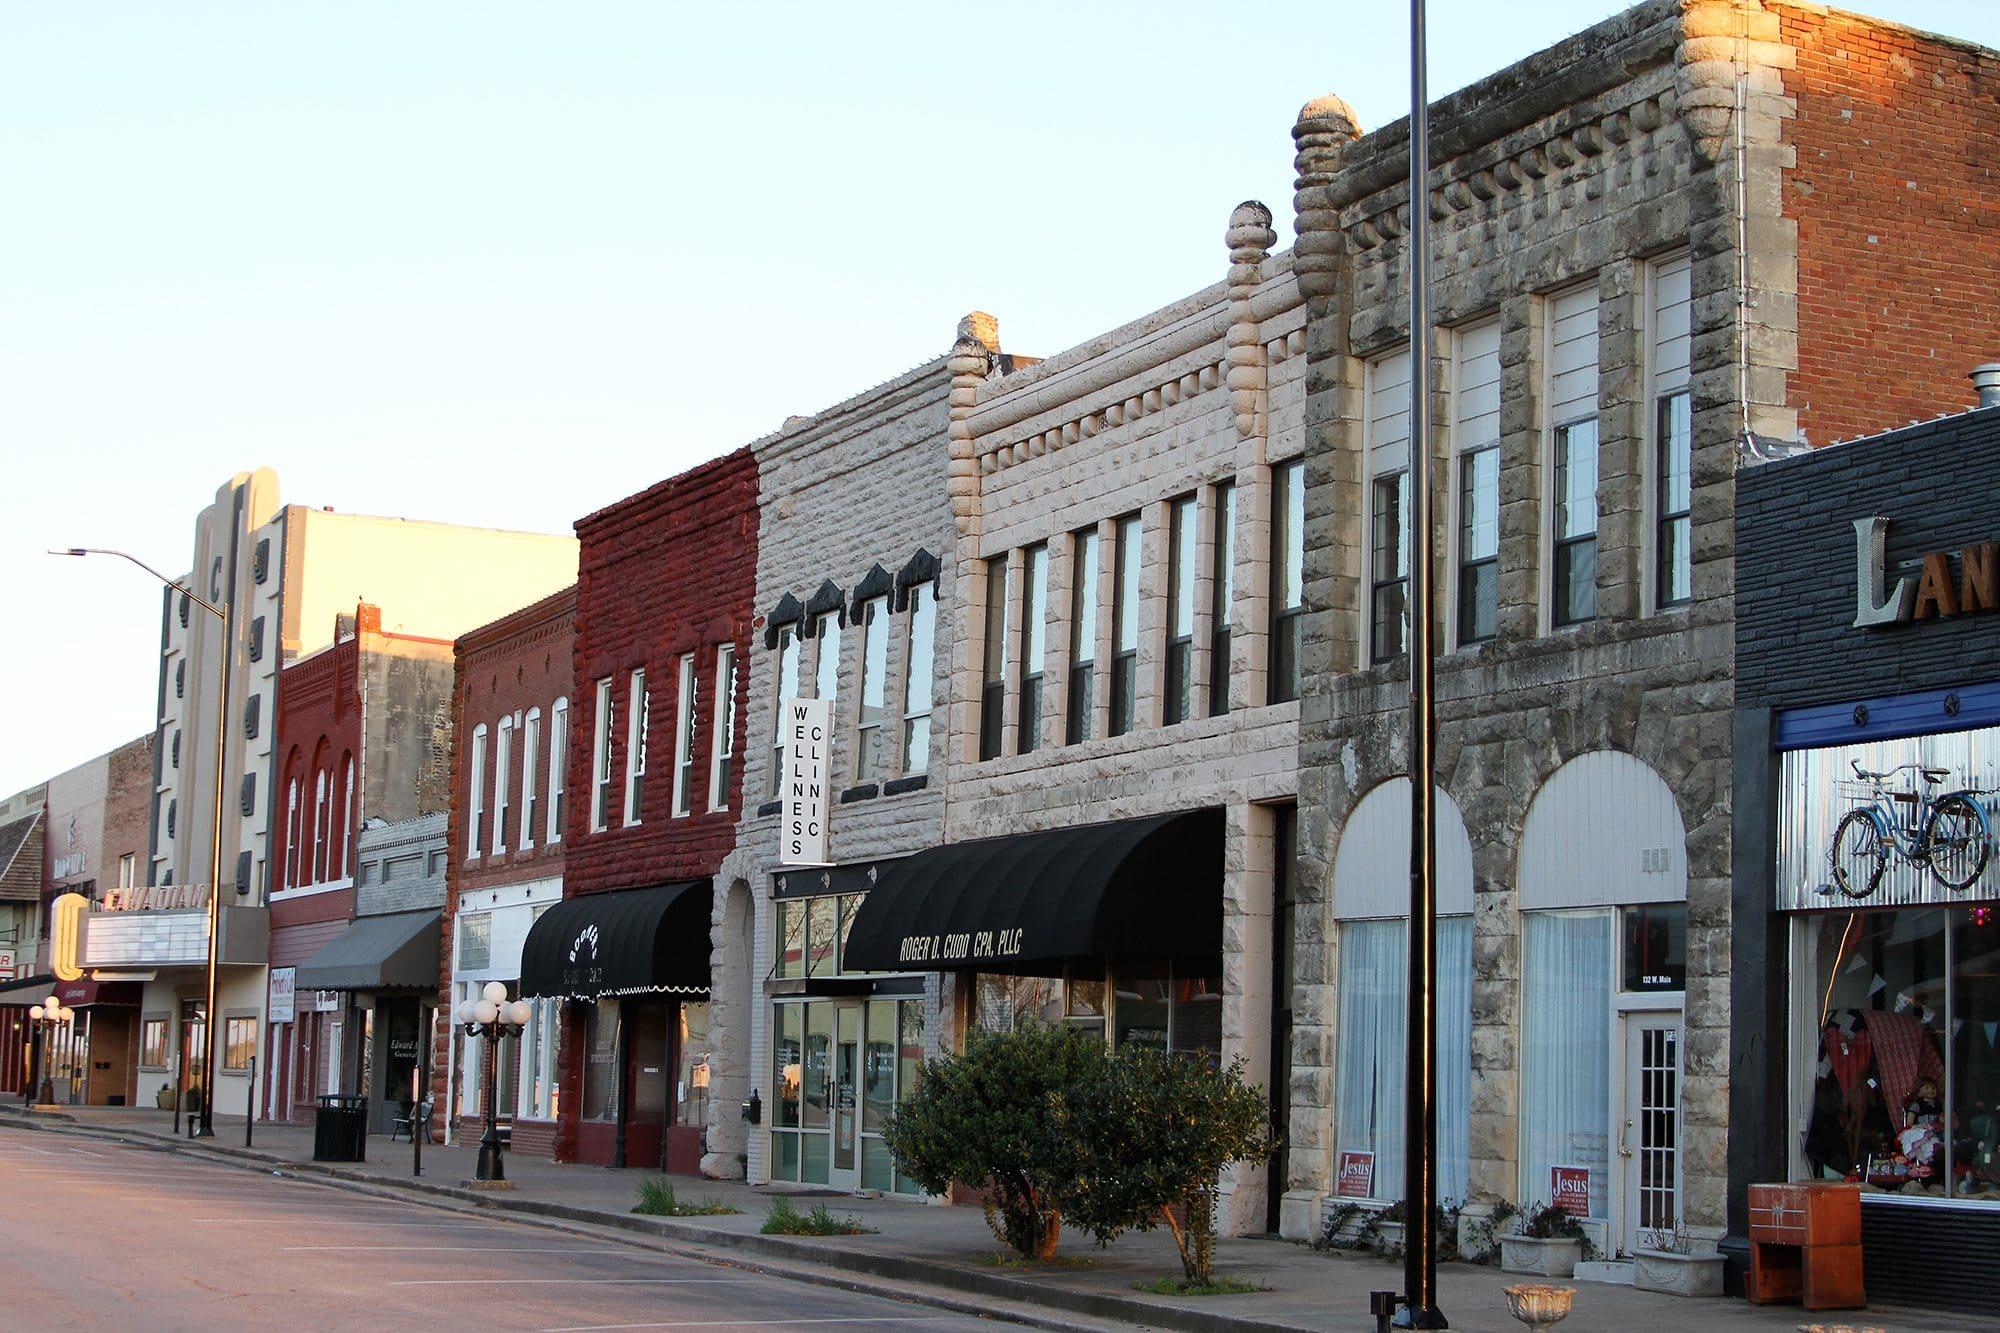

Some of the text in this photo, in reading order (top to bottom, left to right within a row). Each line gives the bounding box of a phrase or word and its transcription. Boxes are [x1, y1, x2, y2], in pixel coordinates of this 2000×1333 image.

[791, 706, 808, 855] WELLNESS
[808, 726, 822, 837] CLINIC
[899, 928, 1023, 962] ROGER D. CUDD CPA, PLLC
[1659, 975, 1672, 984] Main
[390, 1039, 414, 1050] Edward
[1340, 1154, 1370, 1179] Jesus
[1553, 1169, 1587, 1197] Jesus
